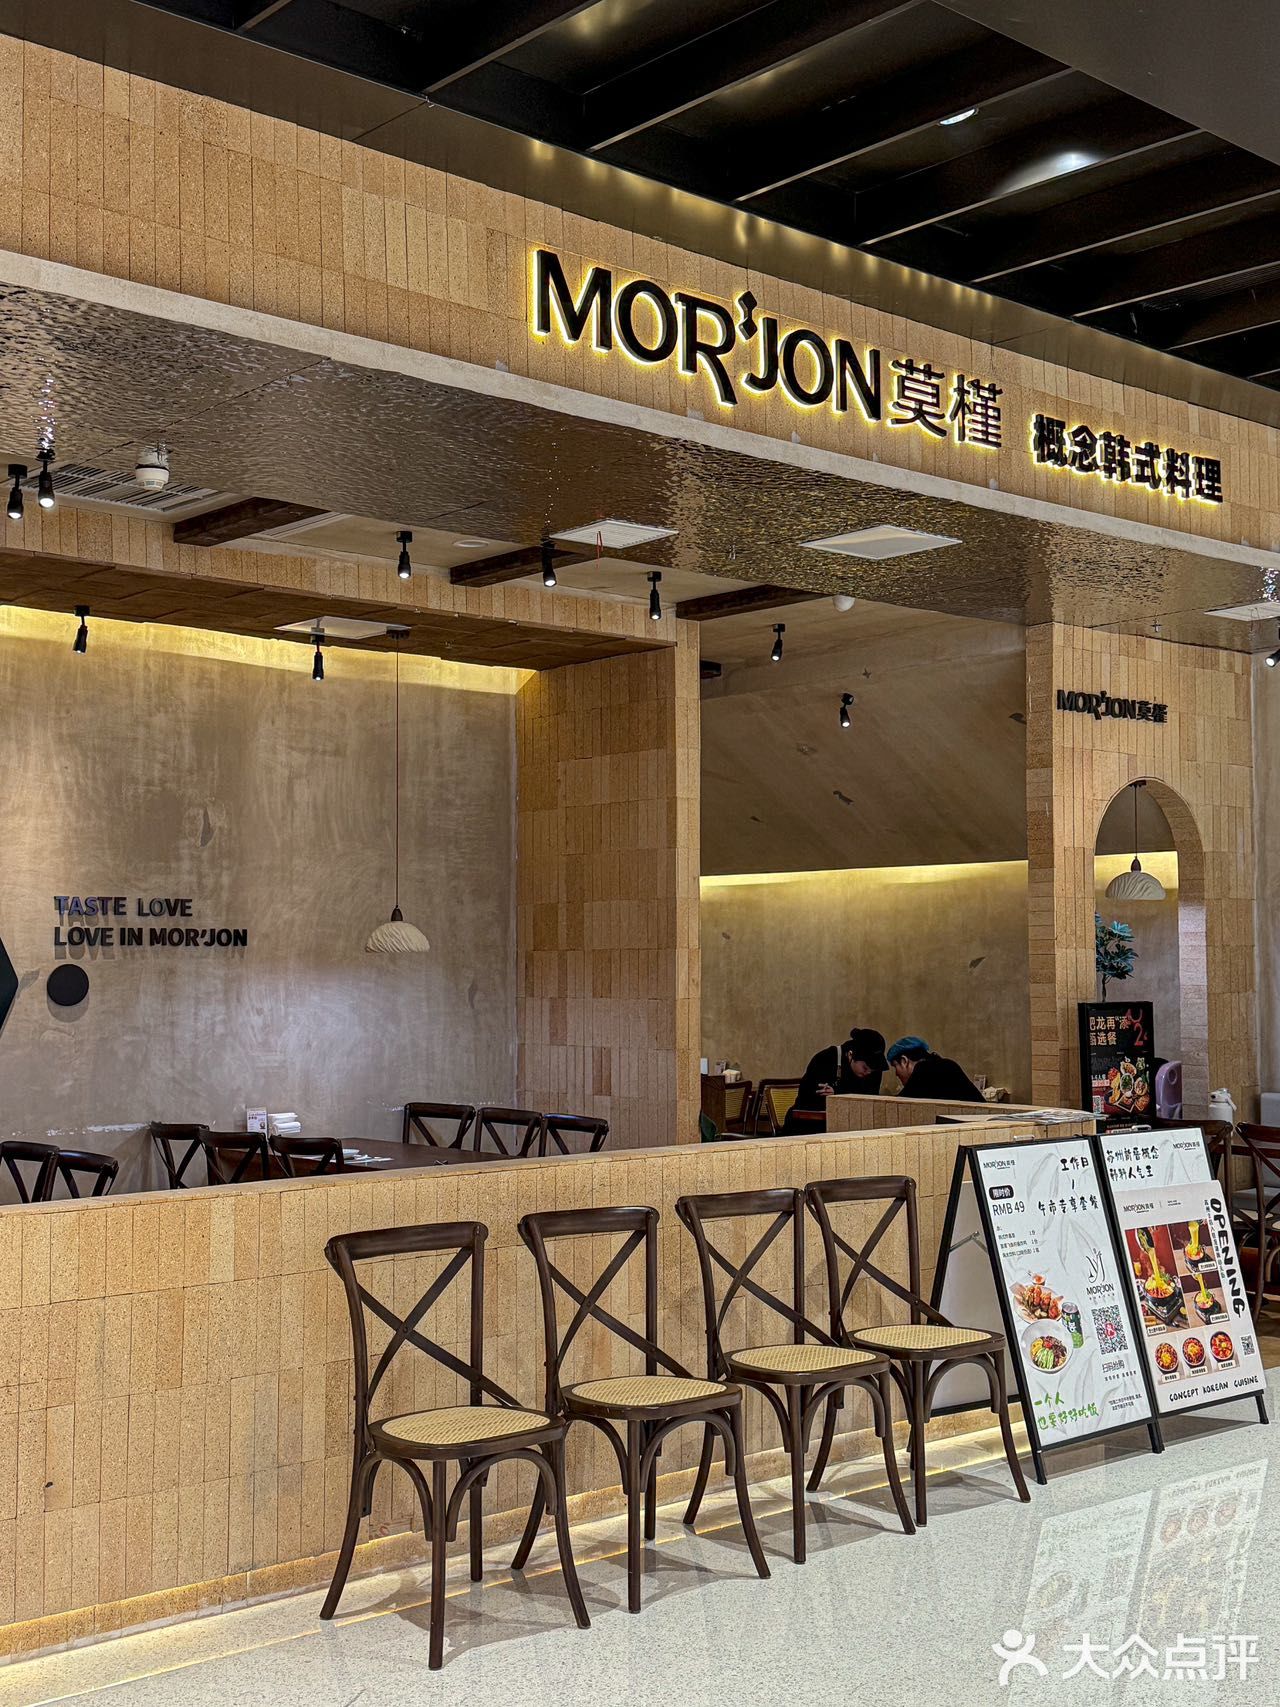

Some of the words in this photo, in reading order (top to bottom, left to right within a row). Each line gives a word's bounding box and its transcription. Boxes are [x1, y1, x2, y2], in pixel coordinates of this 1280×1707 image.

[889, 357, 1004, 449] 莫槿
[1033, 413, 1224, 503] 概念韩式料理
[54, 896, 127, 916] TASTE
[137, 898, 193, 917] LOVE
[54, 926, 114, 946] LOVE
[120, 927, 143, 945] IN
[1060, 1156, 1089, 1171] 工作日
[993, 1202, 1013, 1216] RMB
[1014, 1200, 1025, 1213] 49
[1037, 1194, 1099, 1216] 午市专享套餐
[1209, 1197, 1245, 1318] OPENING
[1034, 1391, 1065, 1408] 一个人
[1169, 1387, 1199, 1402] CONCEPT
[1203, 1381, 1228, 1394] KOREAN
[1234, 1375, 1259, 1388] CUISINE
[1037, 1402, 1099, 1430] 也要好好吃饭
